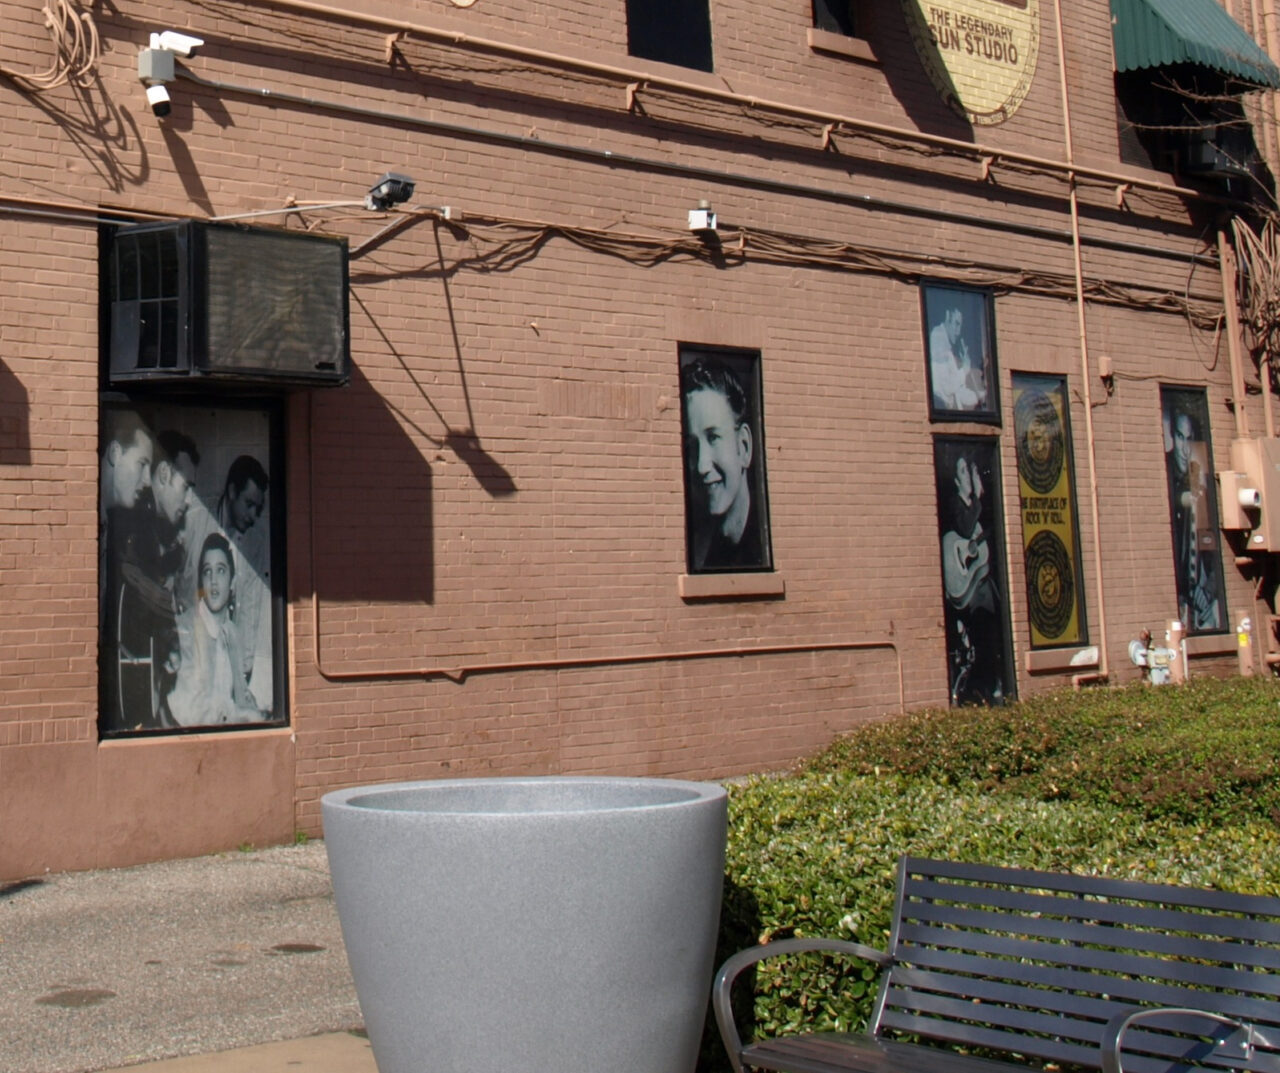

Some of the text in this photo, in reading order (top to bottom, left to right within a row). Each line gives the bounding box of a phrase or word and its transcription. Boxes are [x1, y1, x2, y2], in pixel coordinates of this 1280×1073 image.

[930, 7, 1013, 42] THE LEGENDARY
[928, 24, 1018, 65] SUN STUDIO
